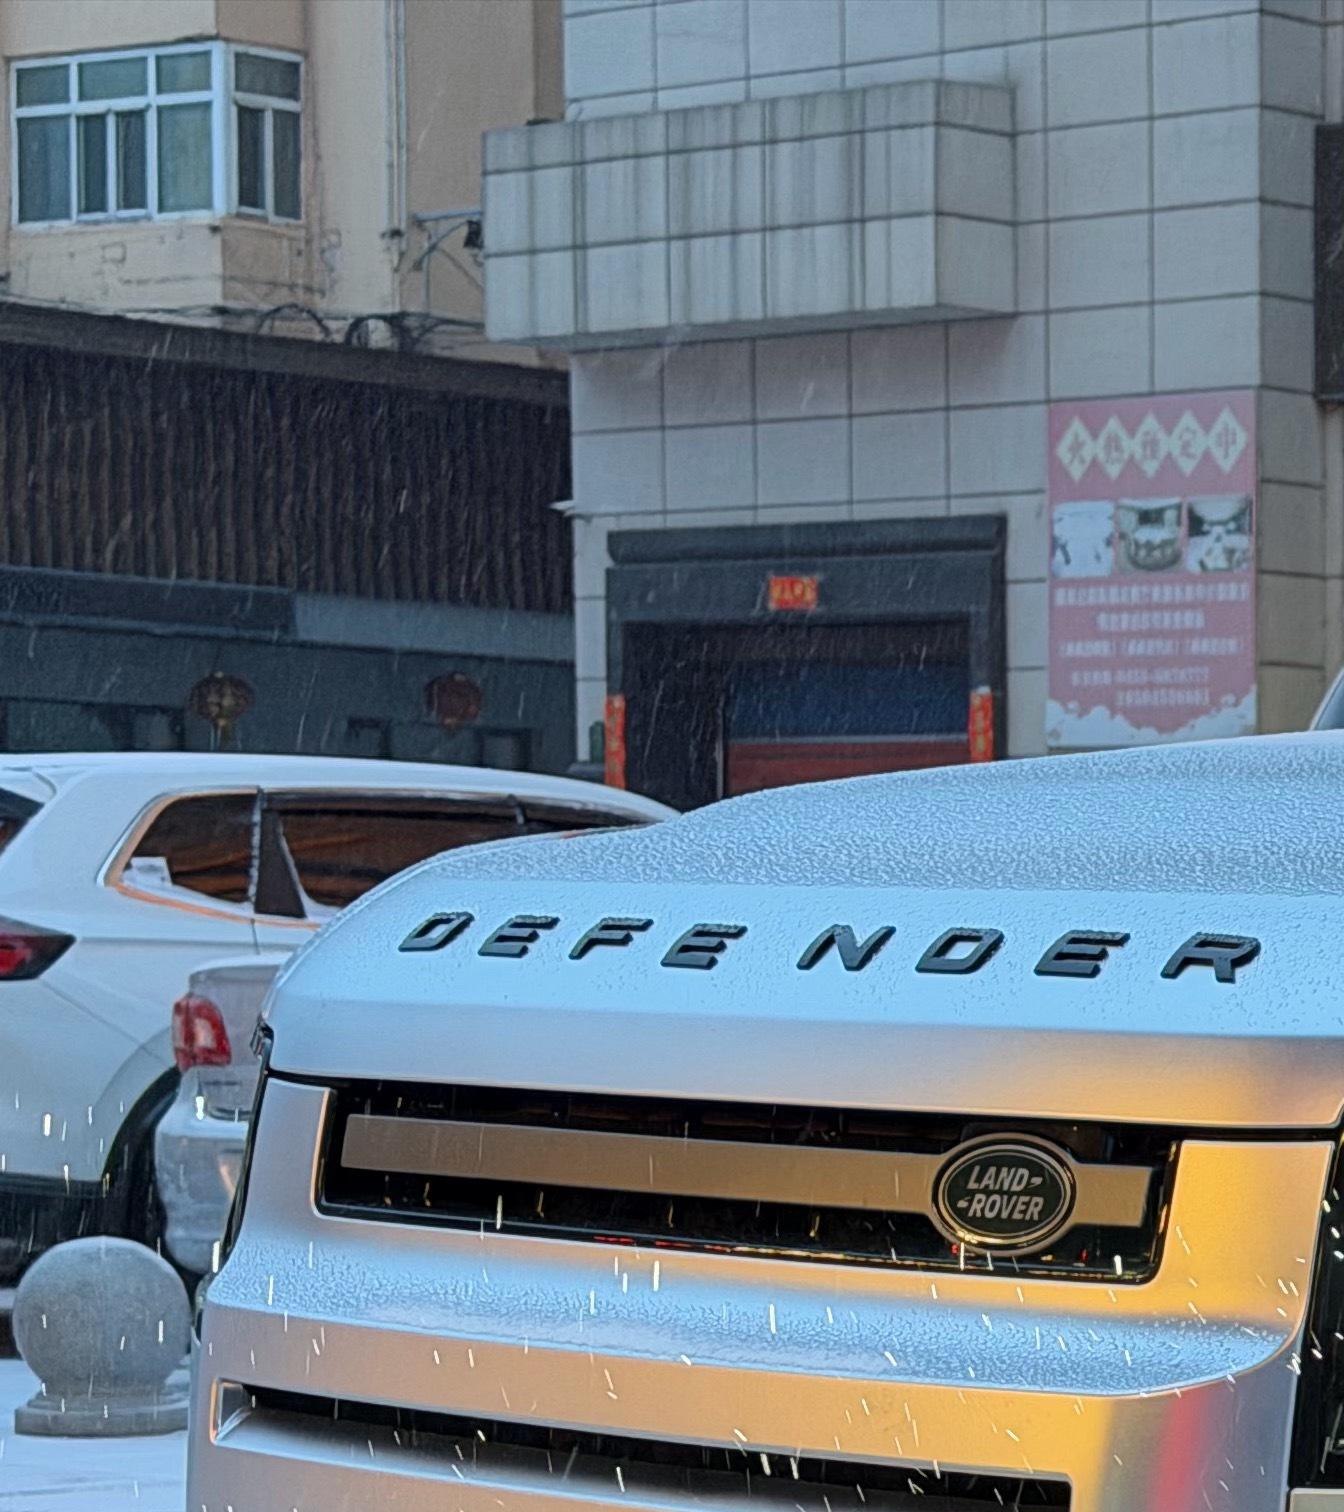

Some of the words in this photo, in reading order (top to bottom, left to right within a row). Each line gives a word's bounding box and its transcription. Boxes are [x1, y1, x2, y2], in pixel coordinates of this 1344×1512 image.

[398, 910, 1262, 984] DEFENDER
[966, 1164, 1030, 1192] LAND
[967, 1193, 1045, 1221] ROVER
